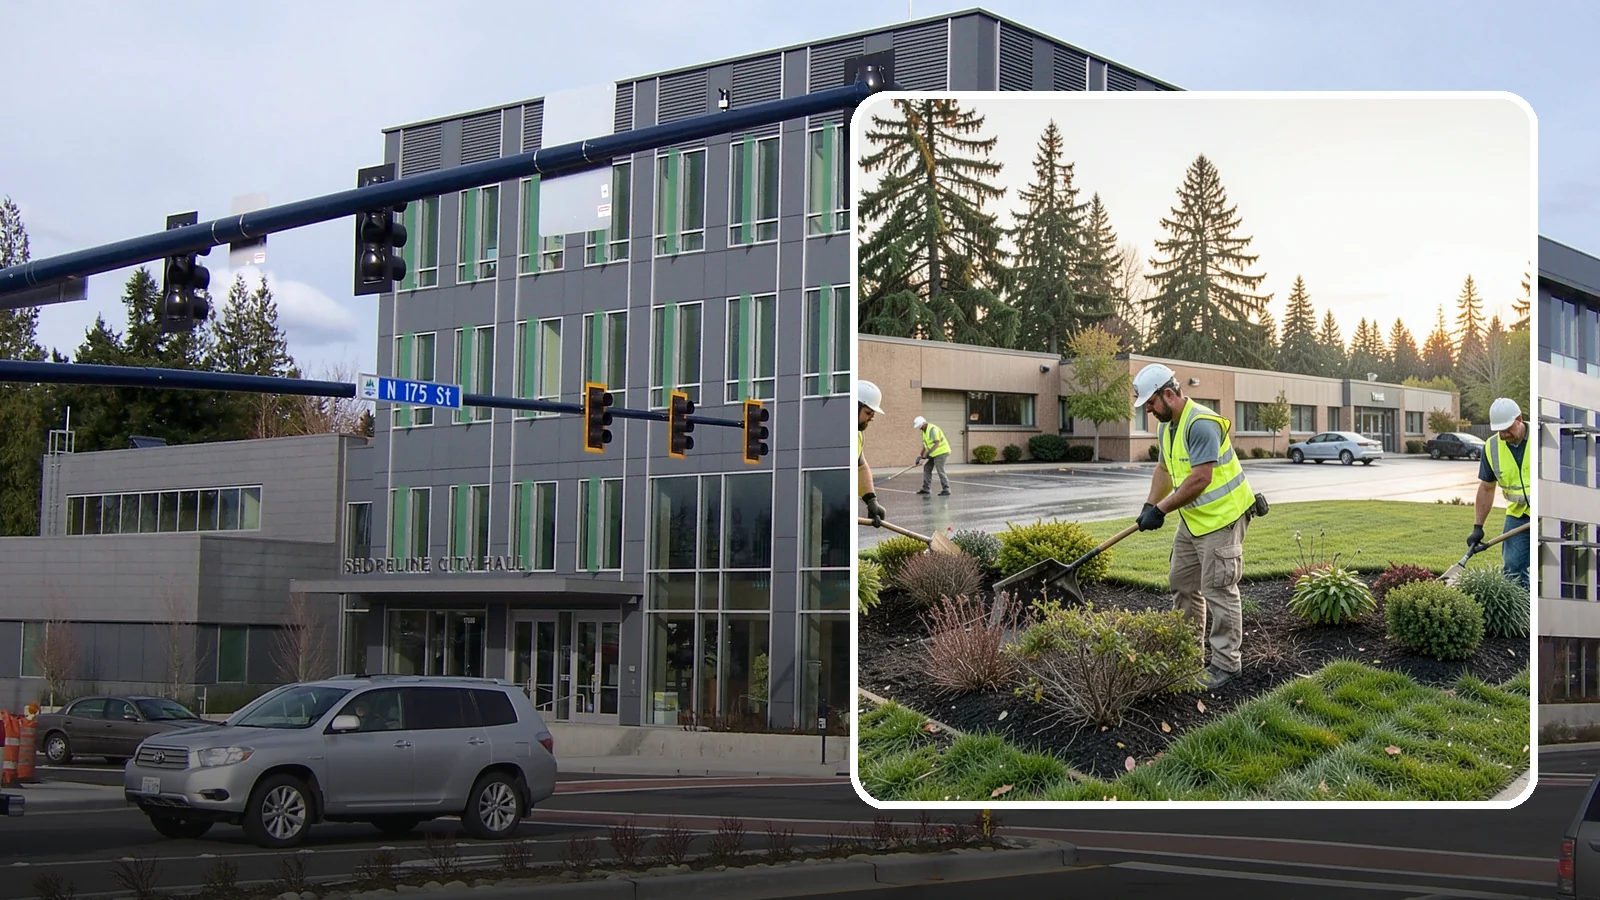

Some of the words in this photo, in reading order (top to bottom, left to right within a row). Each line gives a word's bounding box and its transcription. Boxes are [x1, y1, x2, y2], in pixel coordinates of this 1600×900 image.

[387, 380, 396, 400] N
[405, 382, 427, 403] 175
[436, 386, 451, 406] St
[344, 557, 432, 574] SHORELINE
[438, 556, 475, 573] CITY
[483, 555, 527, 572] HALL
